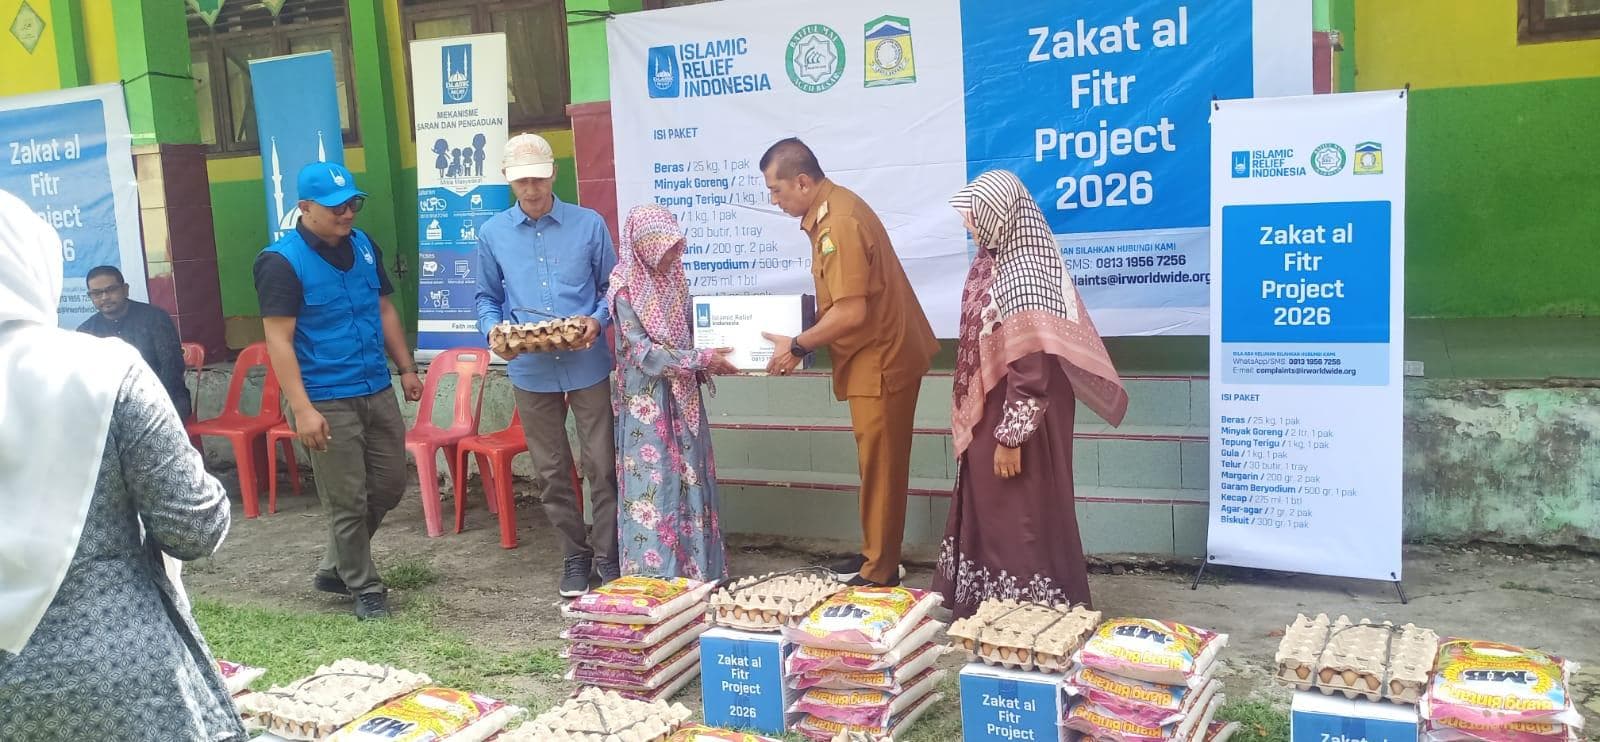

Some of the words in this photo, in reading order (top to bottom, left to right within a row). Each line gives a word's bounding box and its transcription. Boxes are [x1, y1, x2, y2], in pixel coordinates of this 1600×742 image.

[1028, 16, 1141, 63] Zakat
[1152, 6, 1188, 48] al
[680, 38, 748, 61] ISLAMIC
[682, 59, 734, 79] RELIEF
[685, 74, 771, 97] INDONESIA
[1071, 69, 1136, 109] Fitr
[437, 109, 479, 119] MEKANISME
[441, 121, 457, 129] DAN
[458, 118, 503, 128] PENGADUAN
[654, 130, 666, 140] ISI
[669, 128, 698, 139] PAKET
[1035, 117, 1176, 167] Project
[10, 139, 61, 165] Zakat
[65, 134, 81, 160] al
[1253, 149, 1294, 159] ISLAMIC
[655, 163, 684, 173] Beras
[687, 162, 691, 172] /
[694, 161, 703, 172] 25
[732, 159, 750, 173] pak
[1253, 159, 1285, 169] RELIEF
[1252, 167, 1306, 178] INDONESIA
[30, 172, 60, 198] Fitr
[655, 178, 692, 191] Minyak
[695, 178, 729, 190] Goreng
[731, 176, 736, 187] /
[739, 177, 745, 187] 2
[1056, 171, 1153, 210] 2026
[655, 196, 693, 208] Tepung
[696, 194, 727, 206] Terigu
[729, 194, 734, 204] /
[38, 205, 83, 229] ject
[720, 210, 736, 223] pak
[691, 227, 704, 238] 30
[742, 225, 762, 238] tray
[1260, 224, 1326, 245] Zakat
[1333, 223, 1353, 244] al
[684, 244, 703, 255] arin
[705, 244, 711, 255] /
[713, 243, 731, 254] 200
[750, 242, 756, 253] 2
[760, 241, 778, 255] pak
[1076, 246, 1115, 255] SILAHKAN
[1117, 244, 1153, 253] HUBUNGI
[1155, 242, 1176, 251] KAMI
[695, 261, 749, 272] Beryodium
[752, 259, 757, 269] /
[759, 258, 779, 269] 500
[1065, 259, 1092, 270] SMS:
[1096, 257, 1123, 269] 0813
[1127, 256, 1154, 268] 1956
[1157, 254, 1187, 267] 7256
[1284, 251, 1322, 272] Fitr
[694, 276, 699, 287] /
[700, 276, 718, 287] 275
[745, 275, 758, 286] btl
[1071, 272, 1210, 287] laints@irworldwide.org
[1262, 278, 1345, 304] Project
[1274, 307, 1331, 326] 2026
[1256, 367, 1357, 376] complaints@irworldwide.org
[1221, 416, 1245, 424] Beras
[1285, 417, 1300, 427] pak
[1221, 427, 1251, 436] Minyak
[1253, 428, 1283, 438] Goreng
[1291, 428, 1296, 436] 2
[1318, 429, 1334, 439] pak
[1221, 438, 1252, 448] Tepung
[1253, 439, 1280, 449] Terigu
[1314, 440, 1329, 450] pak
[1273, 451, 1288, 459] pak
[1222, 461, 1241, 469] Telur
[1292, 463, 1308, 472] tray
[1222, 472, 1259, 482] Margarin
[1305, 475, 1321, 484] pak
[1222, 483, 1249, 491] Garam
[1251, 484, 1296, 494] Beryodium
[1342, 488, 1357, 498] pak
[1222, 494, 1247, 503] Kecap
[1221, 505, 1263, 515] Agar-agar
[1297, 509, 1313, 518] pak
[1221, 516, 1249, 525] Biskuit
[1293, 520, 1309, 528] pak
[718, 654, 749, 667] Zakat
[752, 657, 762, 668] al
[732, 669, 750, 680] Fitr
[1464, 670, 1527, 684] MB
[722, 681, 761, 695] Project
[1081, 668, 1132, 698] Bintang
[807, 689, 849, 706] Bintang
[850, 692, 883, 704] Blang
[1133, 684, 1173, 706] Blang
[982, 694, 1020, 710] Zakat
[1024, 699, 1036, 712] al
[1504, 695, 1553, 711] Blang
[730, 705, 757, 718] 2026
[999, 711, 1021, 724] Fitr
[1073, 705, 1122, 732] Bintang
[807, 714, 845, 733] intang
[987, 724, 1035, 740] Project
